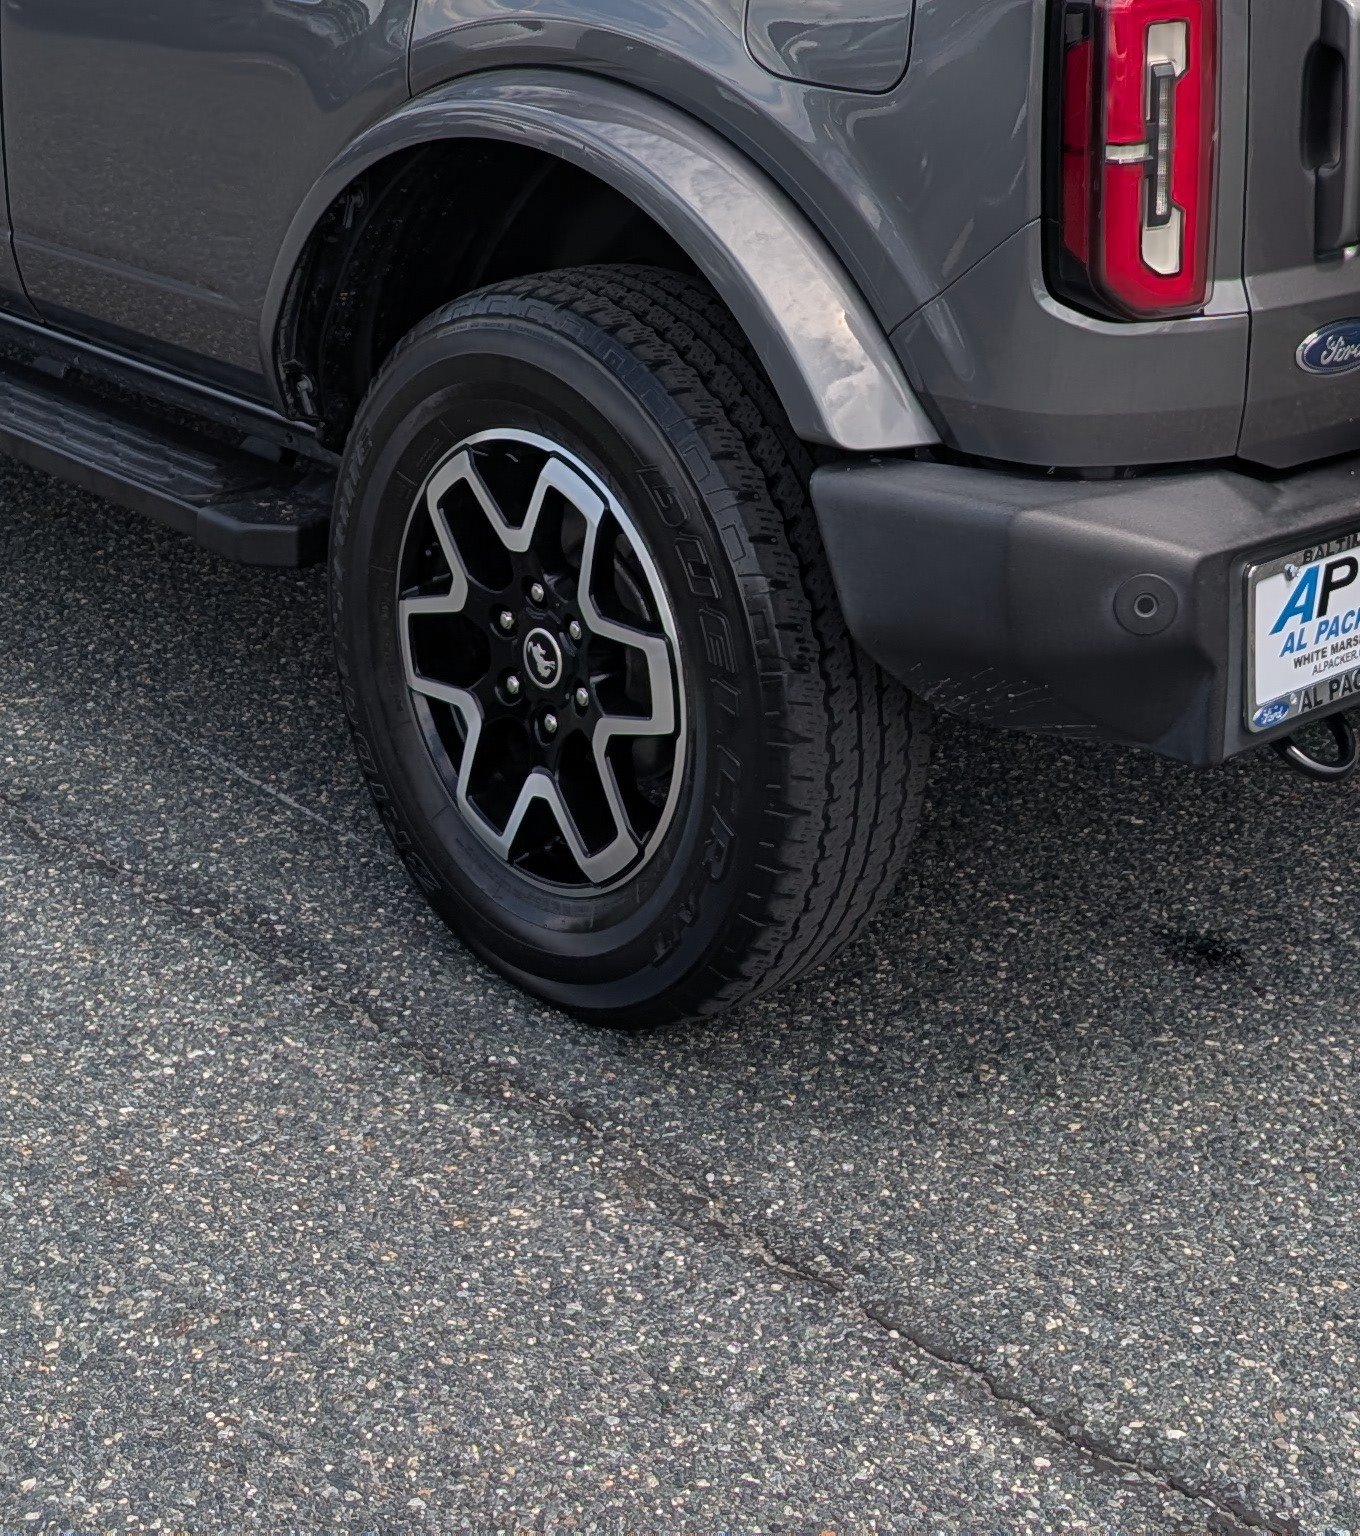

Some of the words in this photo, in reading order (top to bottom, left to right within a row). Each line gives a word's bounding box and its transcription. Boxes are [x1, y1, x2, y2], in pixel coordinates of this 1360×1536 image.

[1268, 555, 1359, 636] AP
[1280, 627, 1307, 657] AL
[1293, 646, 1328, 669] WHITE
[1297, 690, 1323, 714] AL
